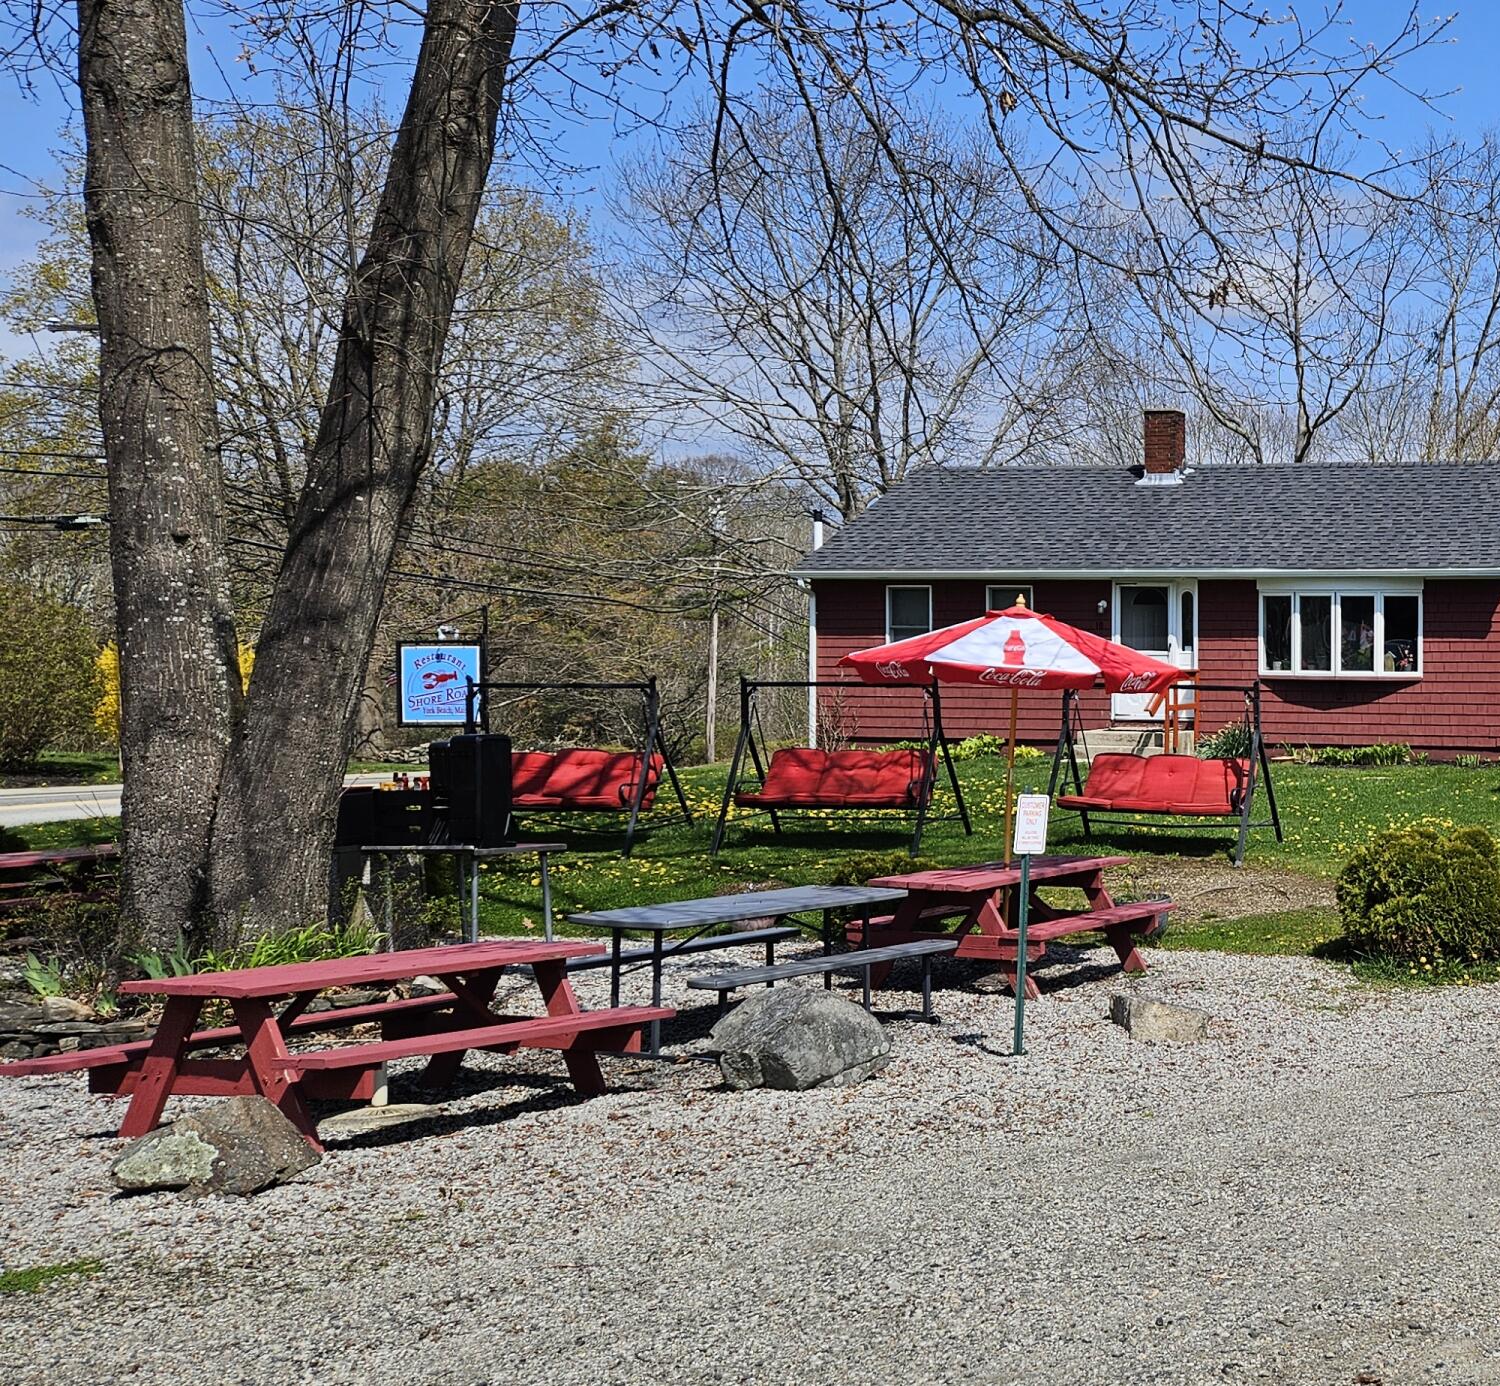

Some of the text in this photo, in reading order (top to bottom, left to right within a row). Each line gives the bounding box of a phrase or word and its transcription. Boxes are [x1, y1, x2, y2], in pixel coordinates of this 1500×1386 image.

[413, 653, 467, 670] Resturant
[979, 668, 1048, 686] Coca-Cola
[408, 687, 468, 709] SHORE ROA
